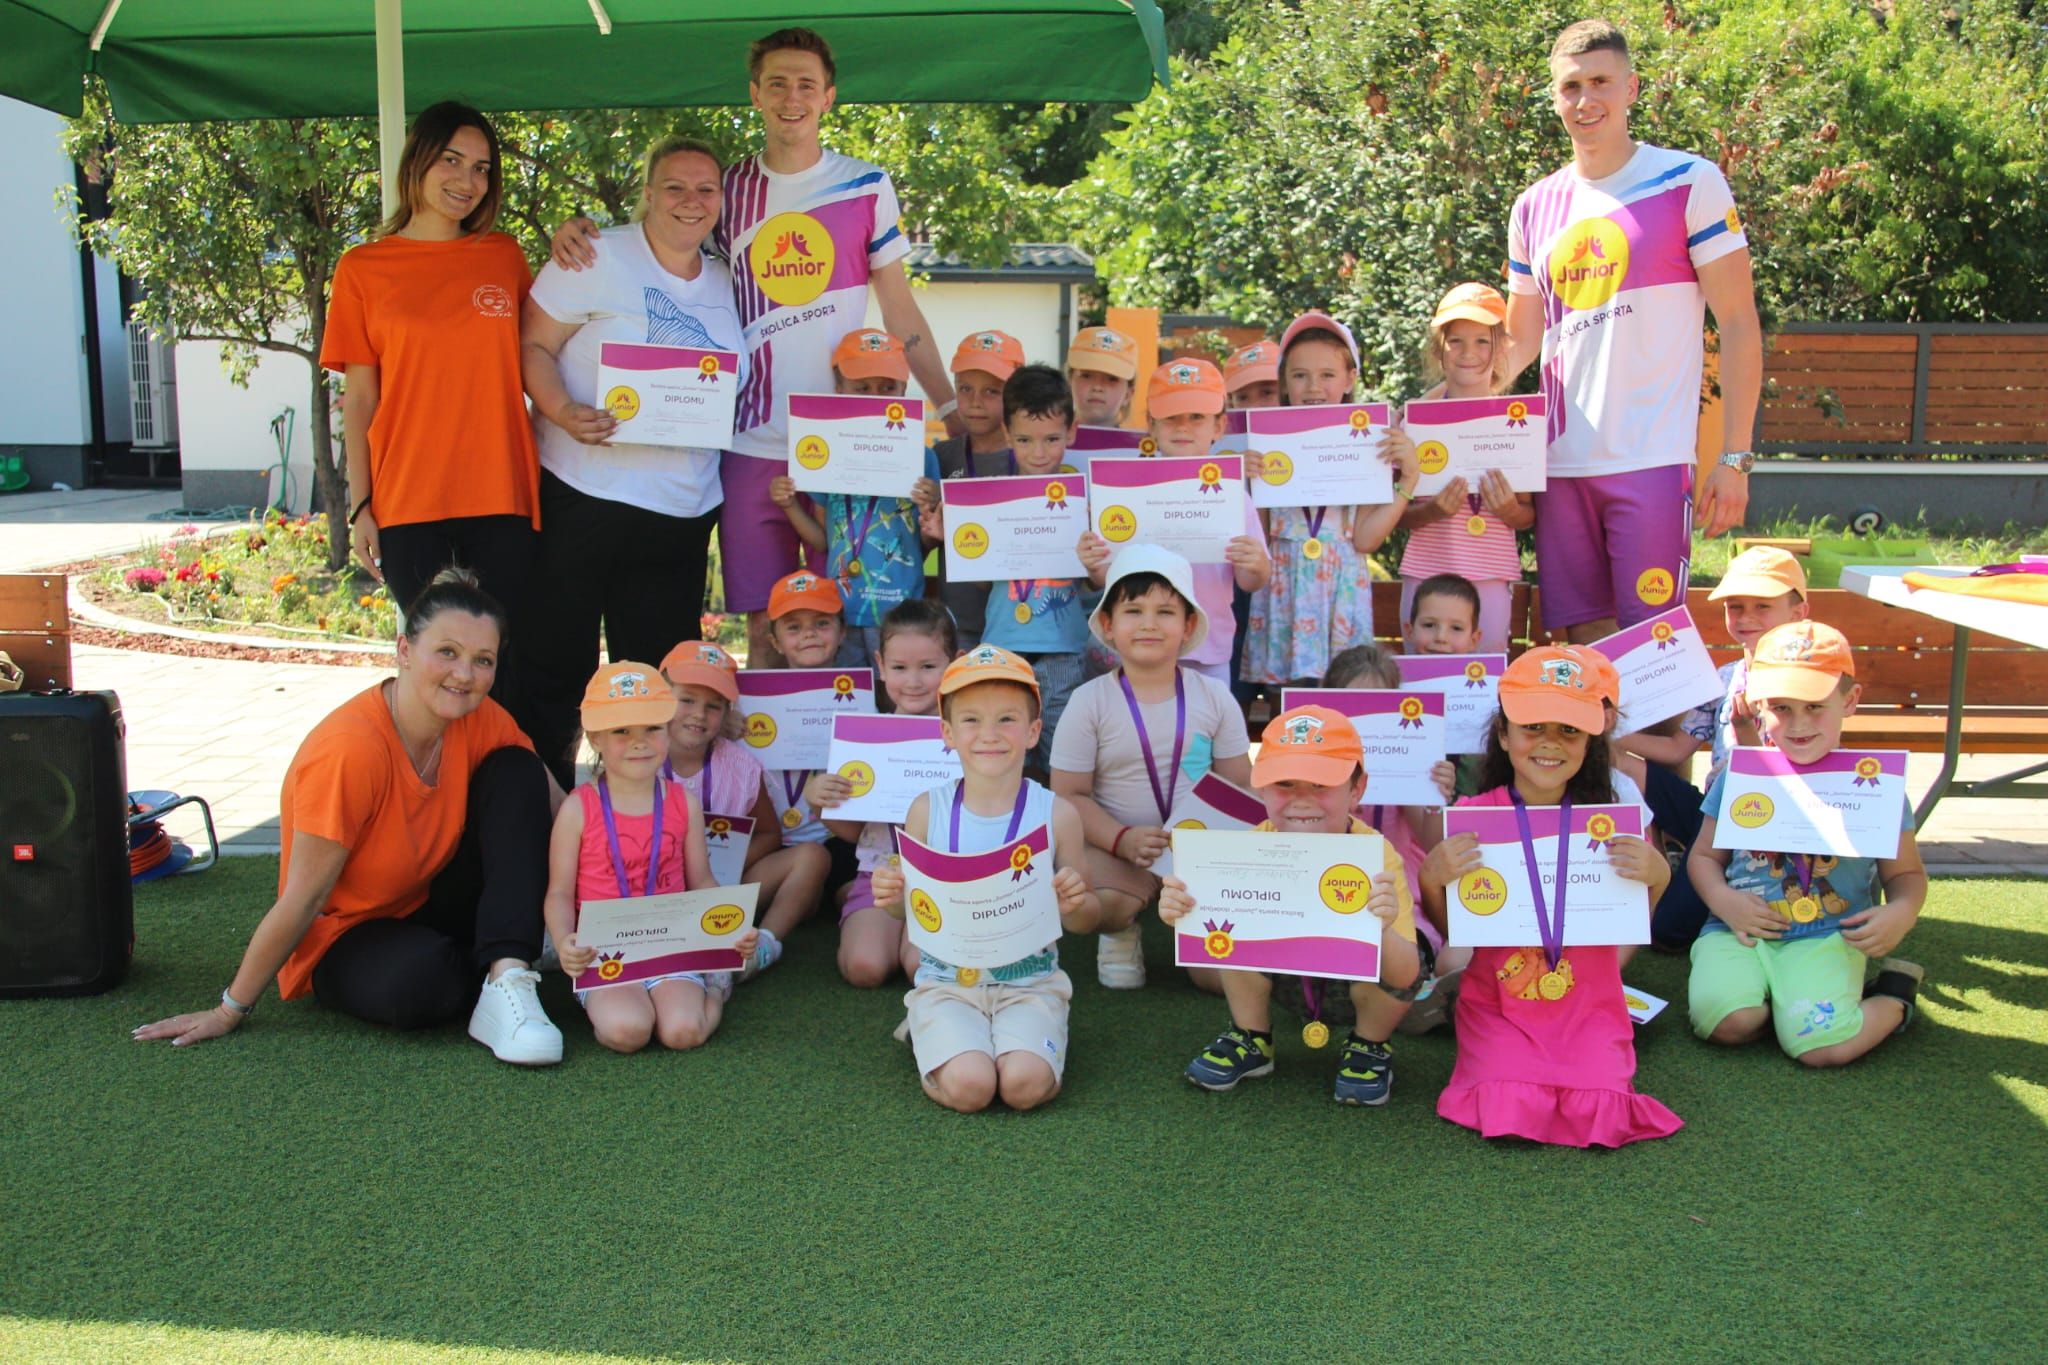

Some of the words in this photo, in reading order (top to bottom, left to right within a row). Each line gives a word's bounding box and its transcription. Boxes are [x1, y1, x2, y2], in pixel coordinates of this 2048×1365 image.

[761, 257, 826, 279] Junior
[1557, 260, 1619, 284] Junior
[1593, 304, 1633, 325] SPORTA
[760, 315, 800, 338] ŠKOLICA
[802, 304, 836, 322] SPORTA
[664, 394, 705, 405] DIPLOMU
[853, 443, 894, 453] DIPLOMU
[1473, 443, 1515, 452] DIPLOMU
[1318, 453, 1360, 463] DIPLOMU
[1164, 510, 1210, 520] DIPLOMU
[1013, 526, 1057, 536] DIPLOMU
[1103, 522, 1132, 532] Junior
[1640, 584, 1669, 596] Junior
[1634, 663, 1677, 686] DIPLOMU
[1446, 703, 1476, 712] LOMU
[1361, 745, 1409, 755] DIPLOMU
[903, 768, 950, 779] DIPLOMU
[1734, 808, 1769, 818] Junior
[1324, 878, 1365, 890] Junior
[1542, 873, 1601, 885] DIOMU
[1220, 888, 1281, 902] DIPLOMU
[1465, 889, 1501, 902] Junior
[972, 897, 1026, 920] DIPLOMU
[706, 911, 740, 922] Junior
[615, 926, 669, 939] DIPLOMU
